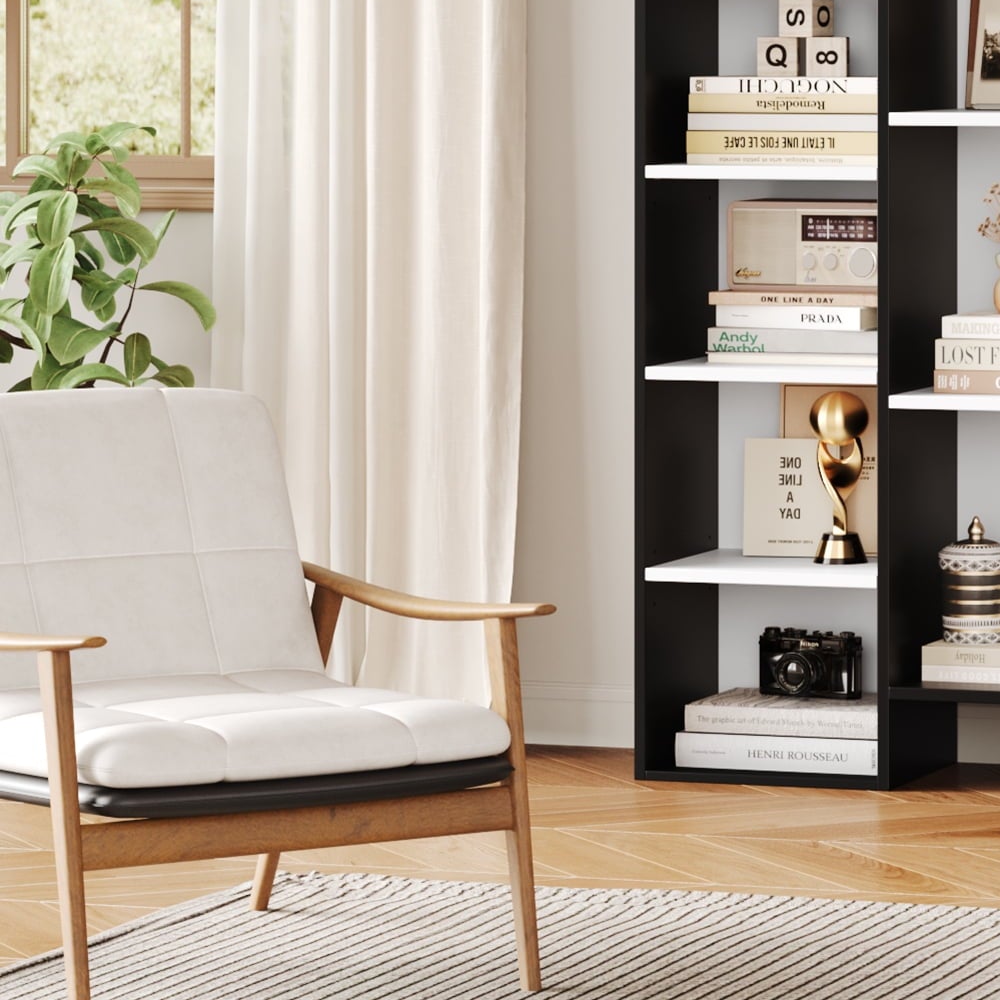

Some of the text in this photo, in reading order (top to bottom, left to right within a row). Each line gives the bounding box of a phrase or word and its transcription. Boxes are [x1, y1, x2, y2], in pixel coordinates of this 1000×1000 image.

[786, 8, 805, 26] S
[765, 44, 838, 68] Q 8
[739, 79, 848, 93] NOGUCHI
[756, 100, 825, 110] Remodelista
[724, 136, 835, 150] IL ÉTAIT UNE FOIS LE CAFÉ
[801, 313, 842, 324] PRADA
[951, 322, 999, 335] MAKING
[719, 332, 758, 345] Andy
[941, 346, 985, 364] LOST
[697, 715, 710, 724] The
[747, 750, 849, 763] HENRI ROUSSEAU
